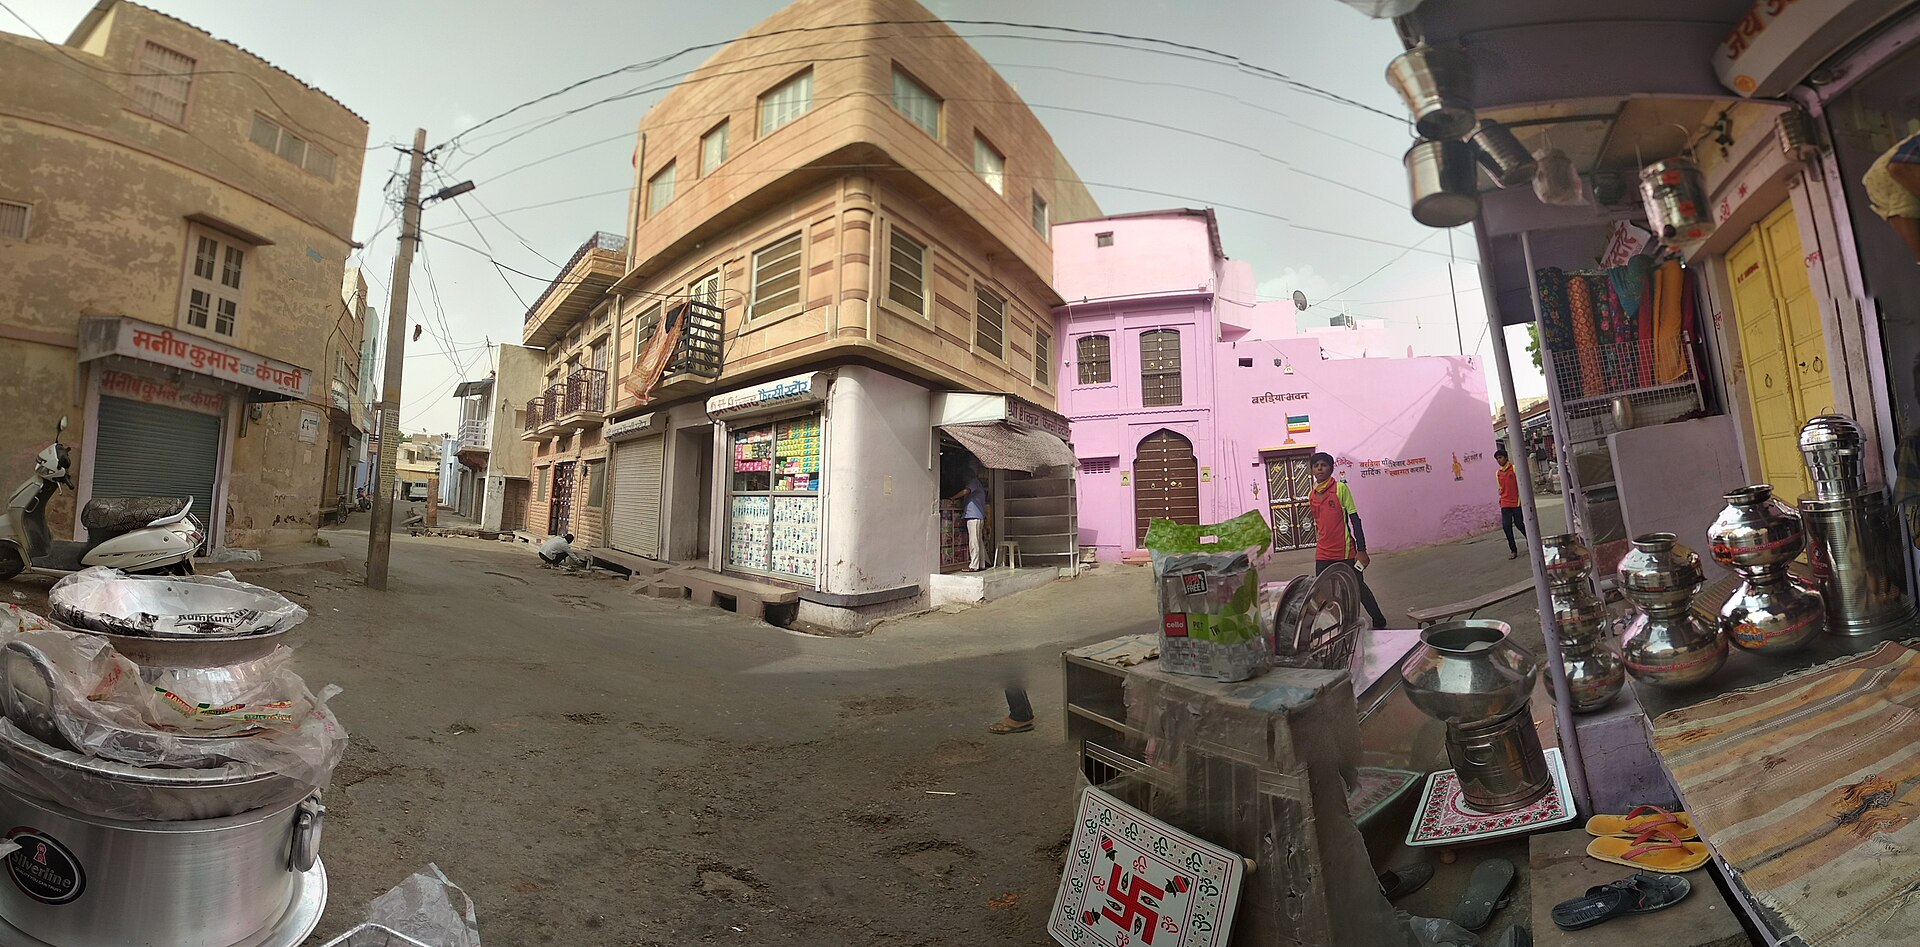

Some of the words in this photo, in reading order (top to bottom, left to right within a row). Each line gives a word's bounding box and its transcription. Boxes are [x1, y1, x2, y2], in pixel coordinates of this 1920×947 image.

[132, 328, 189, 359] मनीष
[188, 344, 240, 375] कुमार
[256, 361, 302, 390] कंपनी
[101, 368, 142, 395] मनीष
[190, 388, 224, 410] कंपनी
[1008, 400, 1018, 418] श्री
[1019, 406, 1040, 426] शंकर
[1186, 584, 1201, 593] FREE
[11, 850, 72, 888] Silverline
[38, 879, 48, 887] CAN
[47, 884, 62, 893] TRUST
